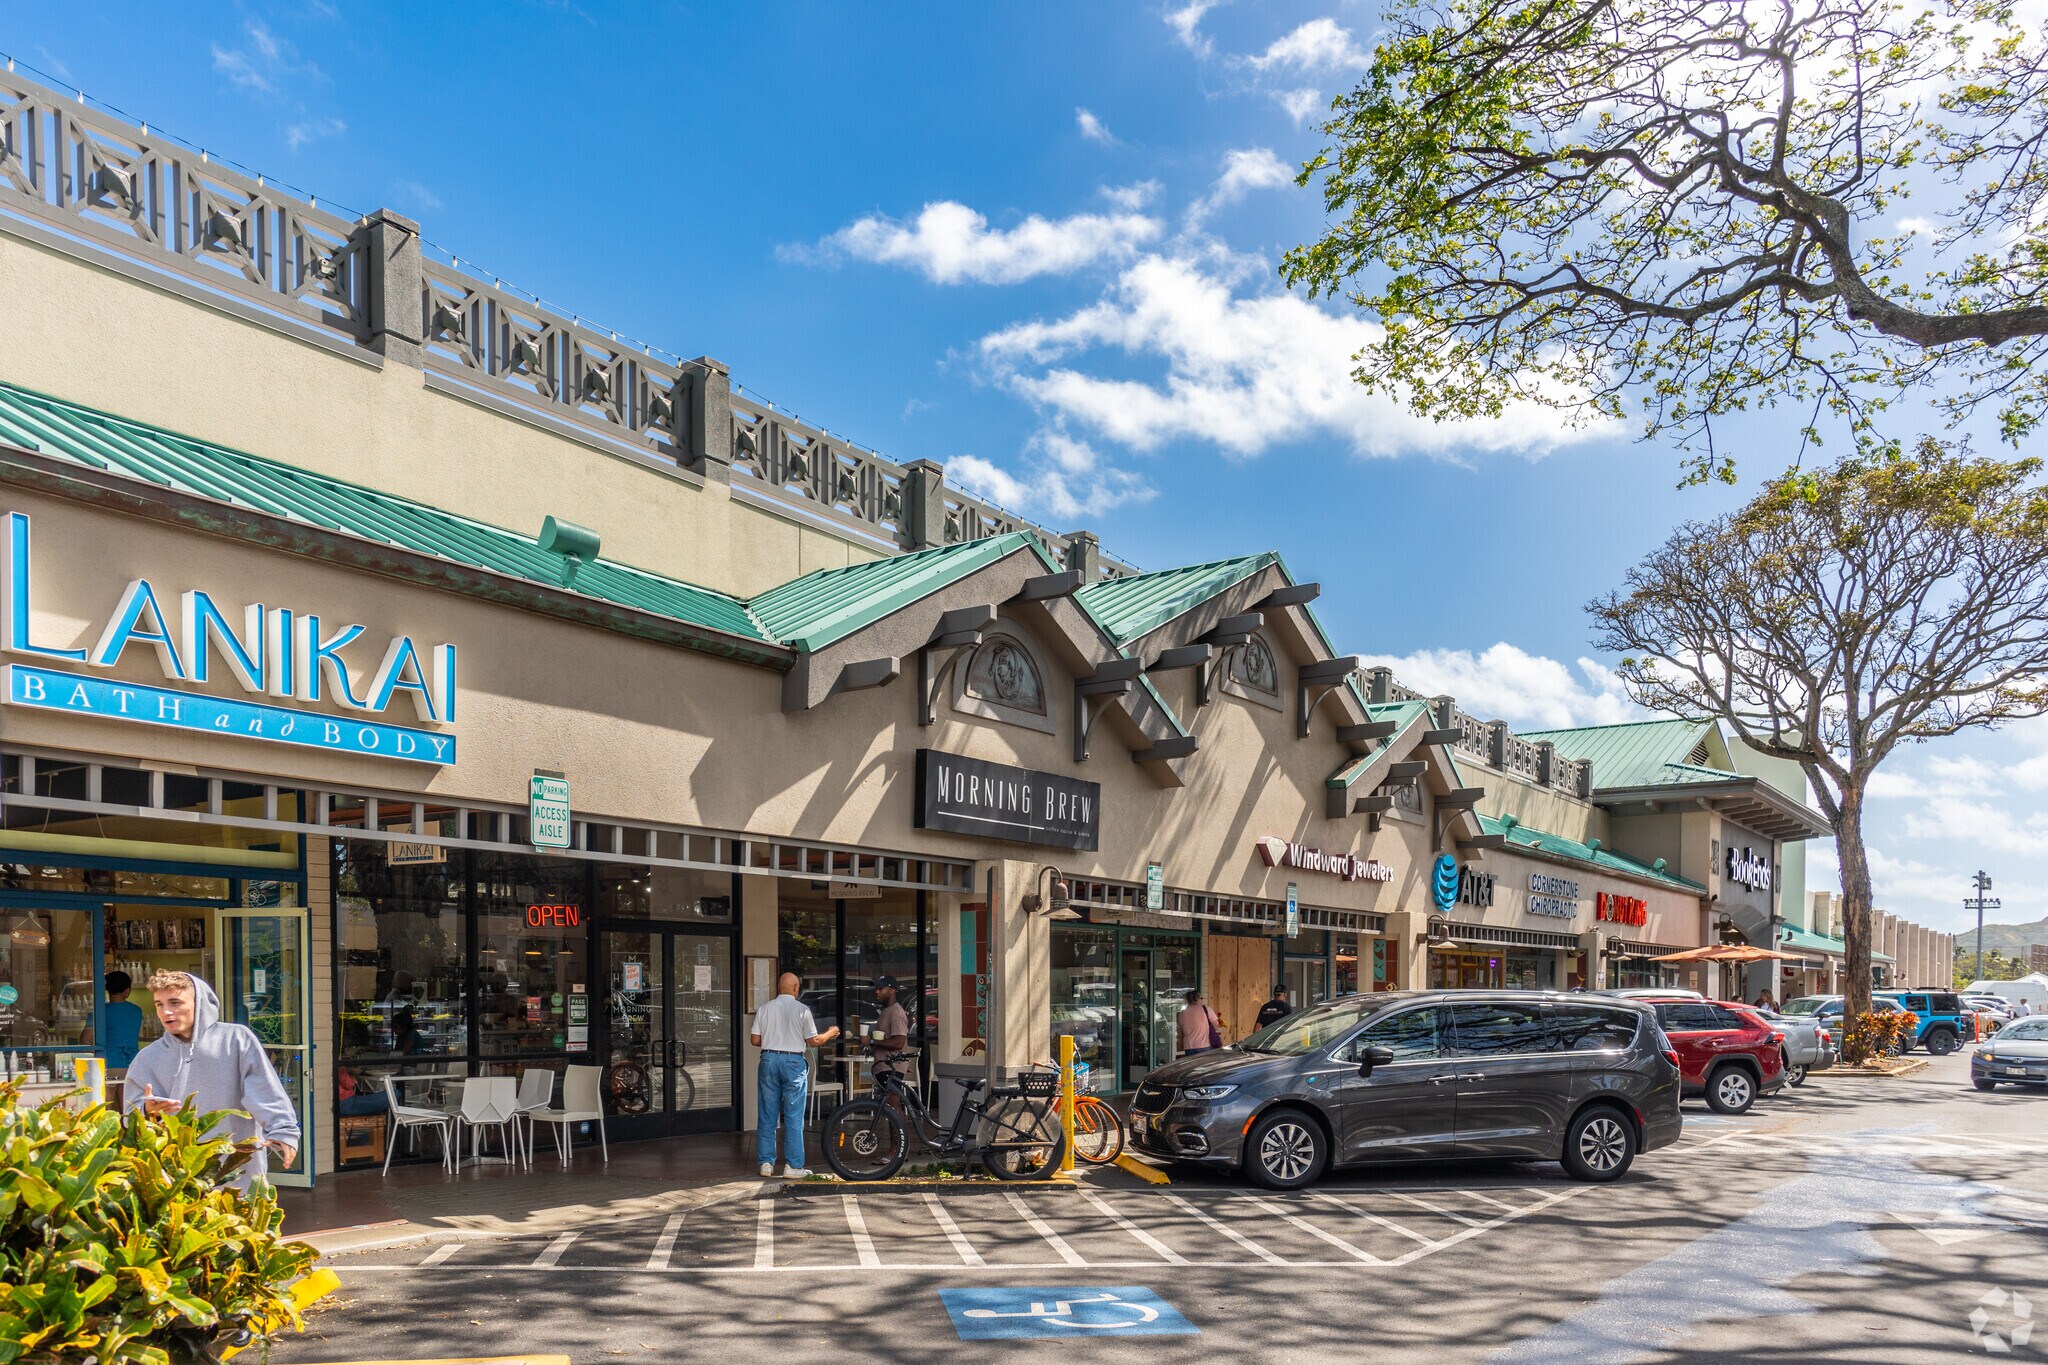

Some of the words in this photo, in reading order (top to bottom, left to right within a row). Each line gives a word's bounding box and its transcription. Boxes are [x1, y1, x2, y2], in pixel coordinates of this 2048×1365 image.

[3, 512, 457, 723] LANIKAI
[23, 675, 181, 721] BATH
[214, 711, 295, 737] and
[324, 720, 452, 760] BODY
[532, 782, 543, 796] NO
[544, 785, 567, 797] PARKING
[937, 765, 1031, 814] MORNING
[1045, 786, 1092, 824] BREW
[534, 806, 567, 821] ACCESS
[539, 824, 563, 838] AISLE
[1290, 843, 1349, 876] Windward
[1350, 855, 1394, 882] Jewelers
[1459, 867, 1498, 907] AT&T
[1532, 873, 1579, 898] CORNERSTONE
[527, 905, 579, 927] OPEN
[1530, 896, 1577, 919] CHIROPRACTIC
[612, 1005, 652, 1014] MORNING
[898, 1128, 906, 1158] KENDA
